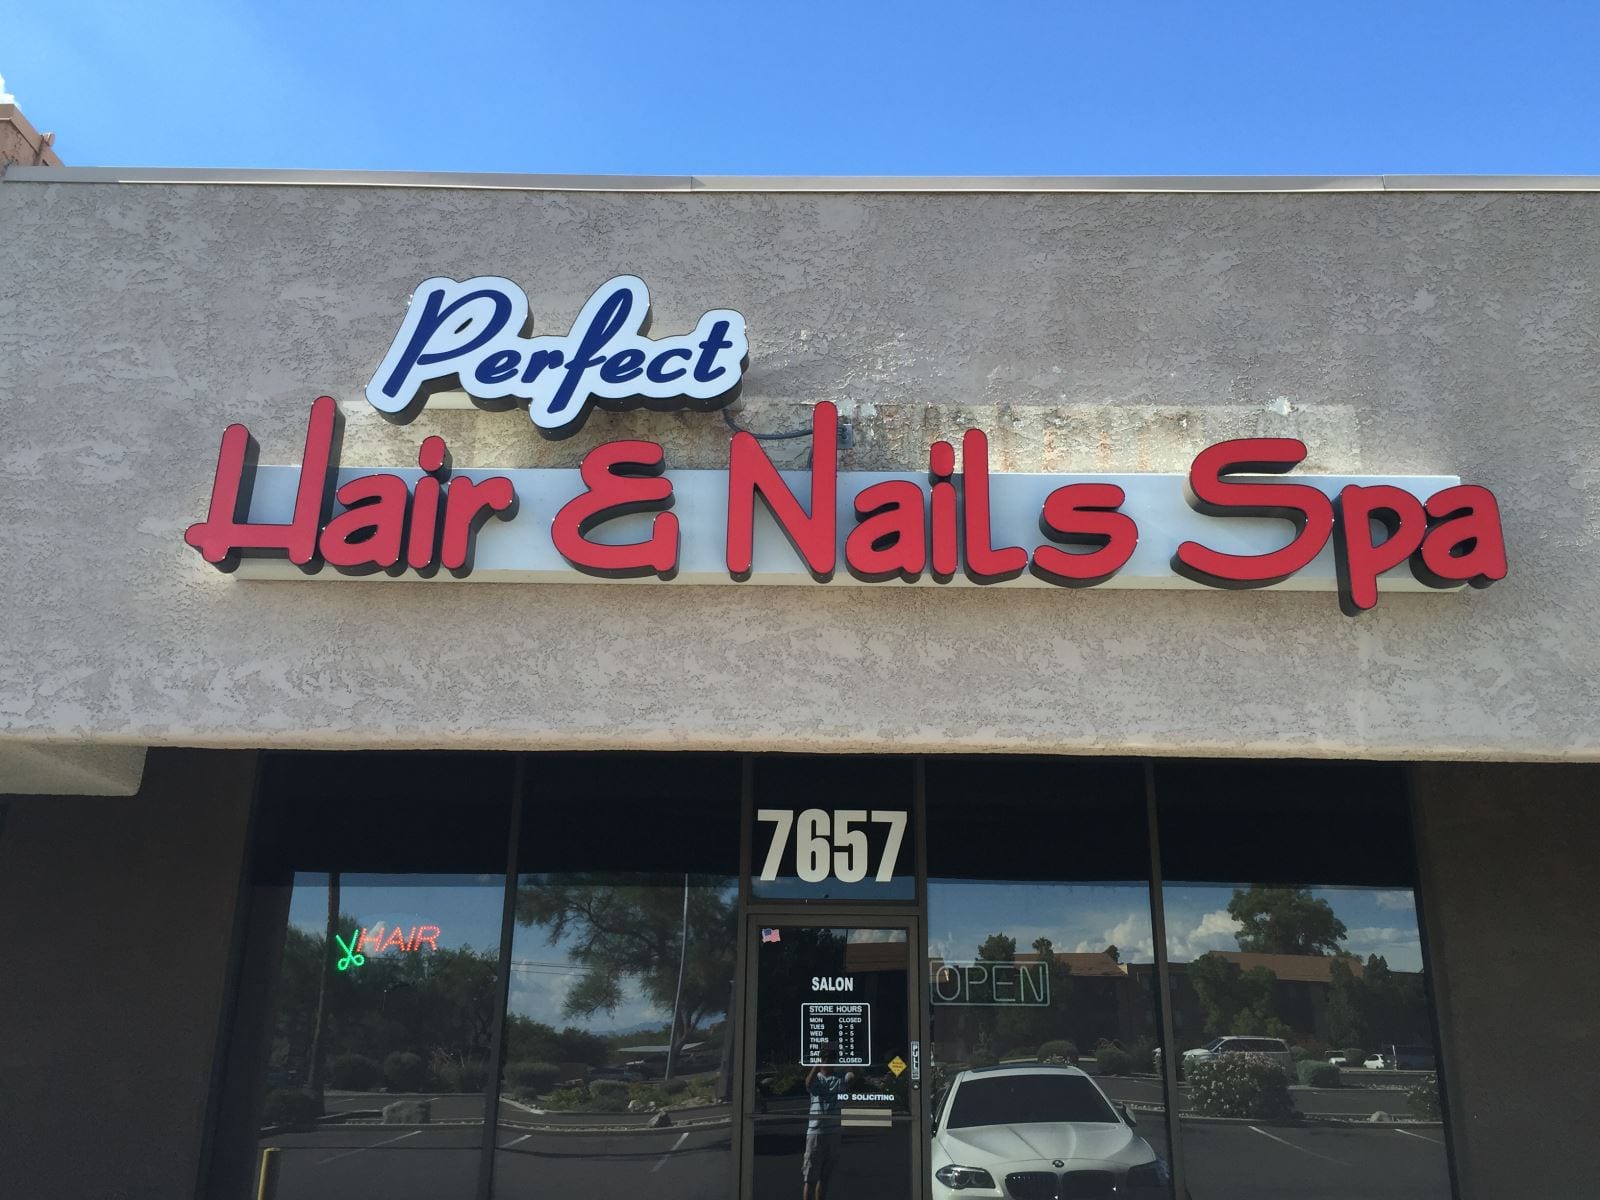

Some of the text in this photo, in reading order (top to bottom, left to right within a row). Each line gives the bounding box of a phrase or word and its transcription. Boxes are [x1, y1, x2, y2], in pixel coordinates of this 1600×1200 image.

[382, 287, 732, 414] Perfect
[184, 395, 514, 570] Hair
[551, 439, 680, 574] &
[1178, 438, 1508, 610] Spa
[757, 808, 908, 883] 7657
[356, 925, 440, 952] HAIR
[811, 976, 854, 991] SALON
[936, 965, 1044, 1002] OPEN
[809, 1005, 862, 1013] STORE HOURS
[851, 1093, 895, 1101] SOLICITING
